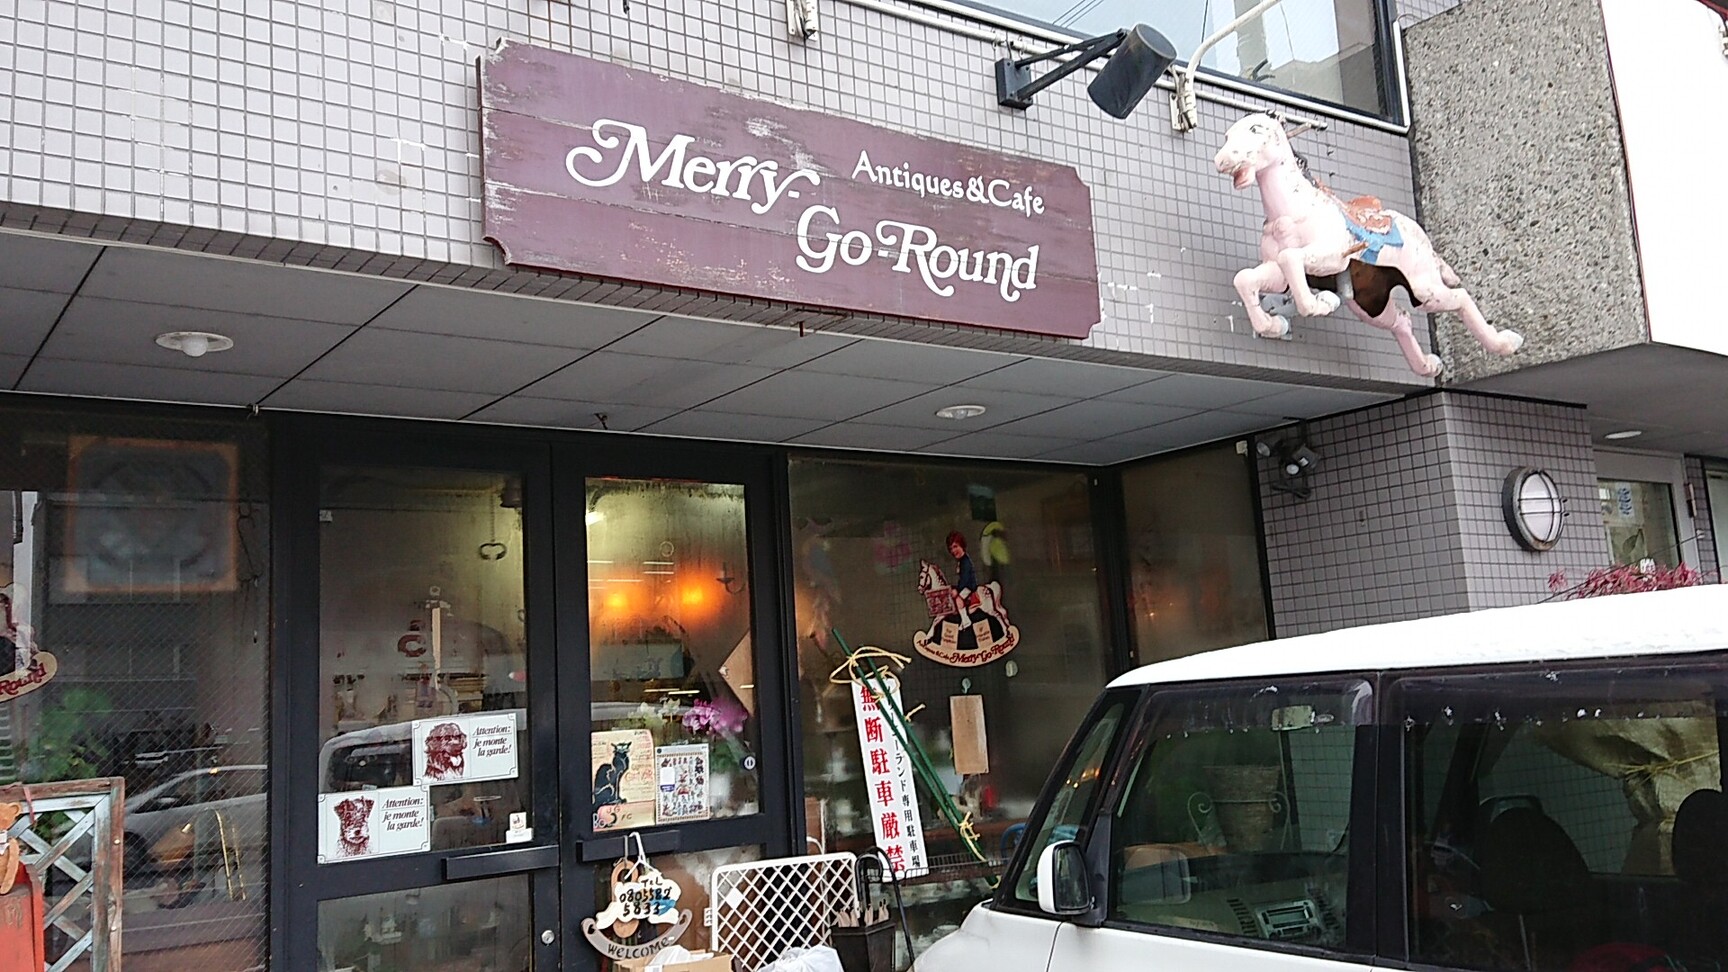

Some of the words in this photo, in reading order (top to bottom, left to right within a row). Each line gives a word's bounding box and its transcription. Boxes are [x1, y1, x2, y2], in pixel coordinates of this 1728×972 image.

[795, 205, 1042, 303] Go-Round
[472, 725, 511, 736] Attention:
[473, 738, 483, 750] je
[482, 737, 508, 747] monte
[477, 747, 486, 757] la
[486, 745, 512, 757] garde!
[860, 685, 906, 873] 無断駐車厳禁
[382, 797, 424, 809] Attention:
[382, 812, 392, 823] je
[392, 810, 419, 821] monte
[386, 821, 396, 832] la
[395, 817, 424, 831] garde!
[622, 901, 661, 918] 5833
